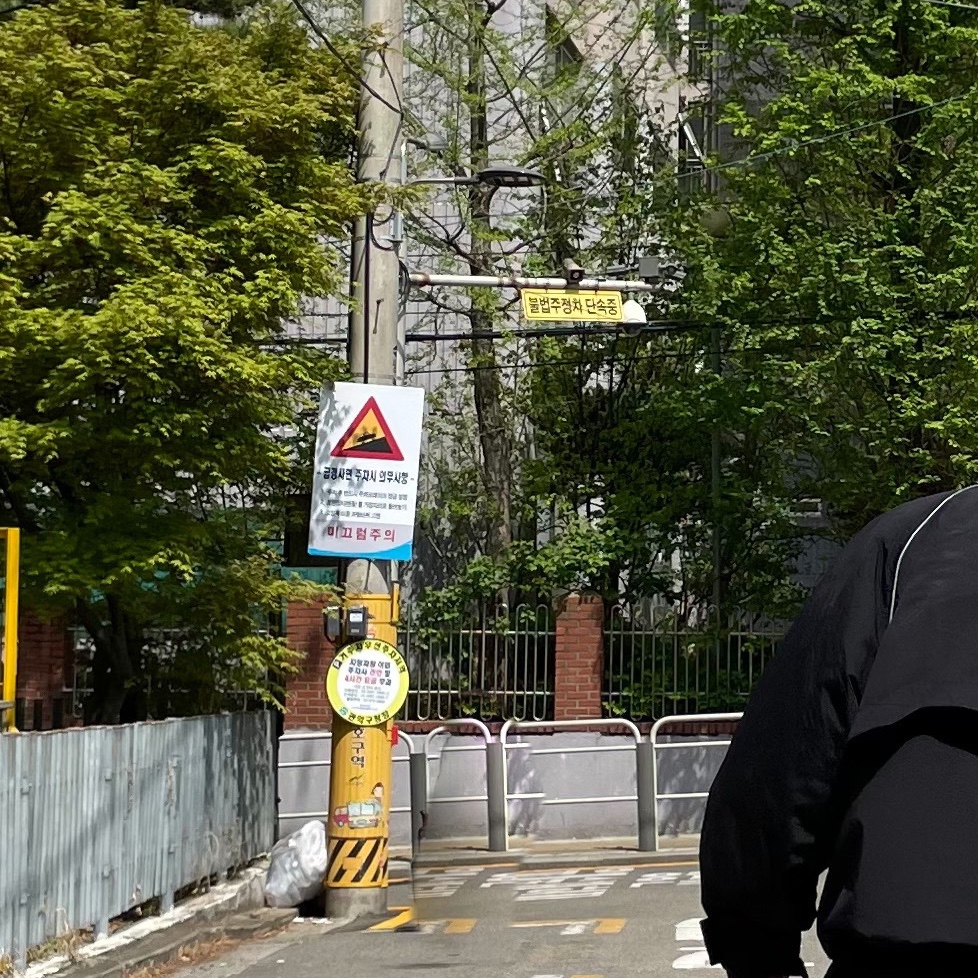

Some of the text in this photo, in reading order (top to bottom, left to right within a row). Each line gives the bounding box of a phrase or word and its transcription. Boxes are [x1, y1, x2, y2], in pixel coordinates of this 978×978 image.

[528, 296, 618, 316] 불법주정차 단속중
[354, 468, 377, 483] 주차시
[379, 469, 409, 485] 의무사항
[327, 525, 396, 543] 미끄럼주의
